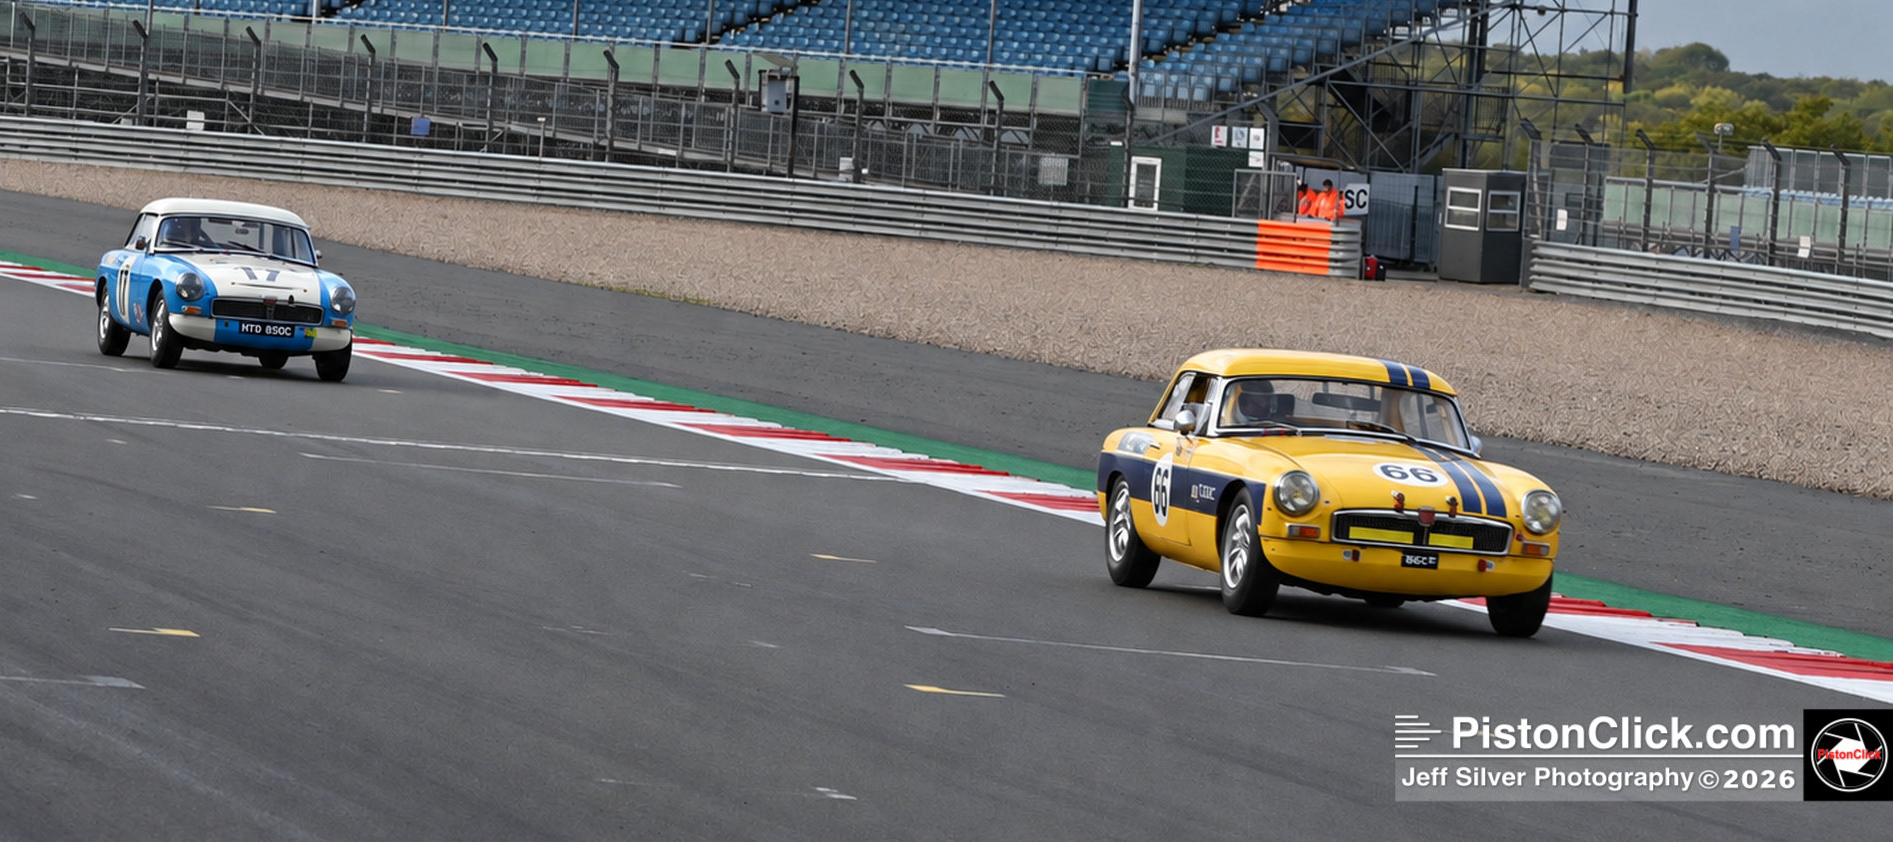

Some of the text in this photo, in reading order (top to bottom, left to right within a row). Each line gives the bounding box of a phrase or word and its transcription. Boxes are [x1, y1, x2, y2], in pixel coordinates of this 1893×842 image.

[1345, 188, 1367, 209] SC
[235, 266, 281, 282] 17
[1379, 464, 1439, 483] 66
[1155, 466, 1169, 517] 66
